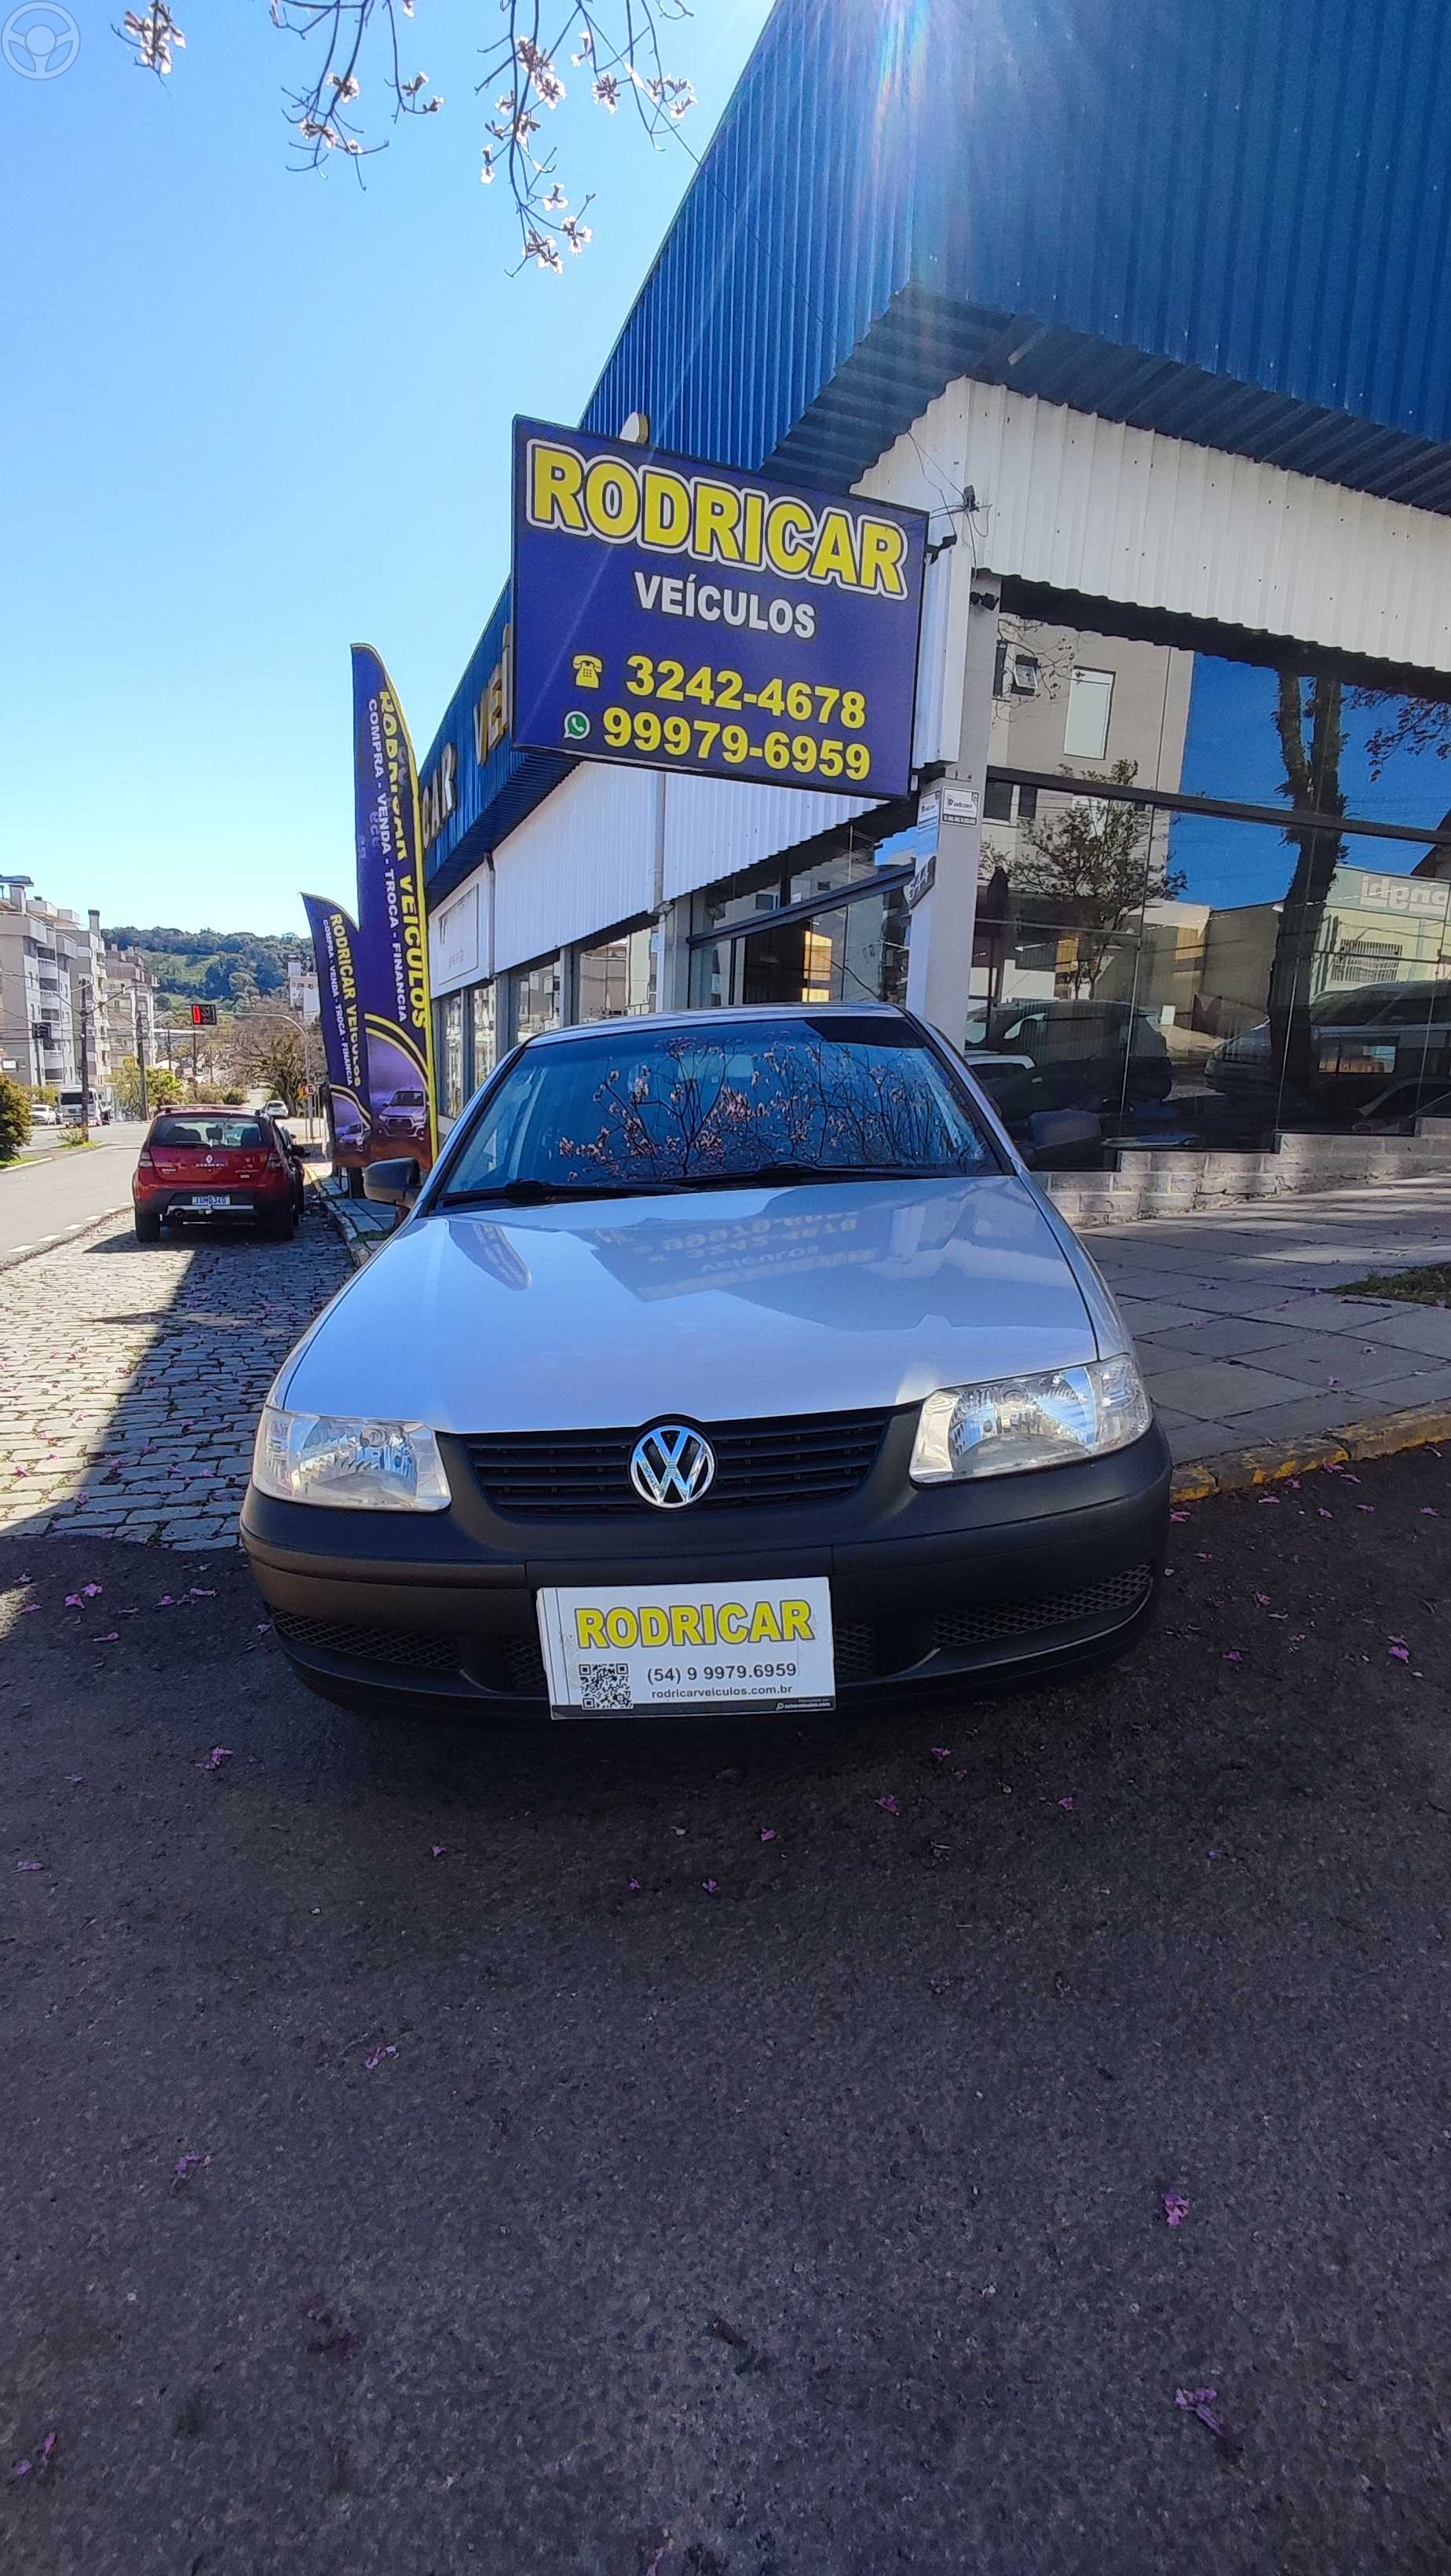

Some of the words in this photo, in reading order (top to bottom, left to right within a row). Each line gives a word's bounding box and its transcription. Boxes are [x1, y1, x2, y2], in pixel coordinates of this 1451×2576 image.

[528, 440, 908, 600] RODRICAR
[634, 572, 816, 639] VEÍCULOS
[626, 655, 866, 730] 3242-4678
[368, 697, 384, 779] COMPRA
[603, 707, 871, 781] 99979-6959
[377, 792, 392, 855] VENDA
[385, 868, 400, 929] TROCA
[323, 919, 334, 960] COMPRA
[330, 913, 356, 1001] RODRICAR
[329, 964, 340, 998] VENDA
[392, 942, 408, 1023] FINANCIA
[334, 1004, 346, 1037] TROCA
[574, 1599, 815, 1649] RODRICAR
[647, 1666, 682, 1685] (54)
[687, 1667, 697, 1681] 9
[704, 1663, 797, 1681] 9979.6959
[651, 1685, 793, 1699] rodricarveiculos.com.br
